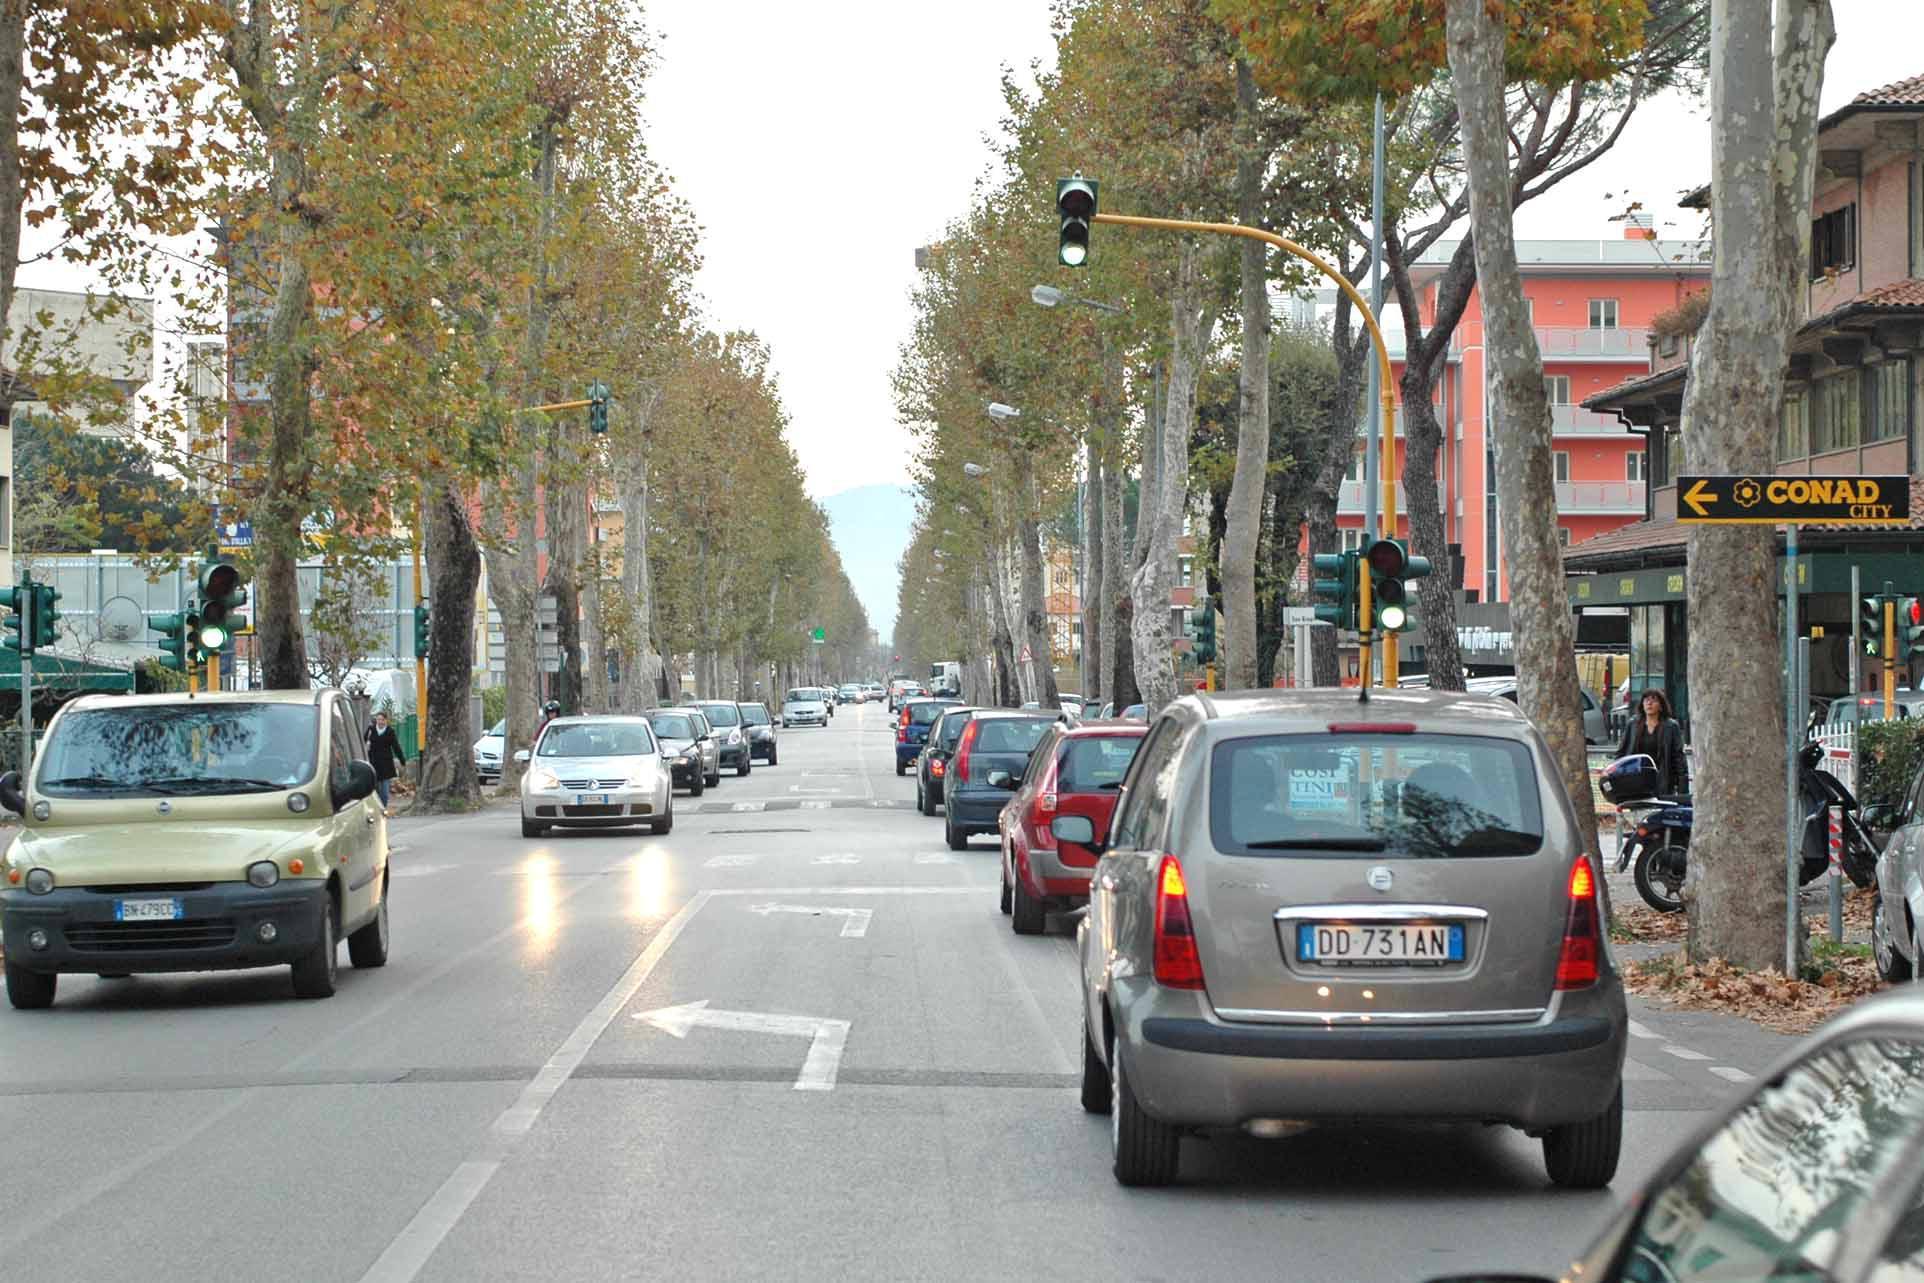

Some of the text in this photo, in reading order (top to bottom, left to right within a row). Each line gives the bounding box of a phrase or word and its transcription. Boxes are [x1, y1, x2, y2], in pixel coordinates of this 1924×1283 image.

[1766, 480, 1880, 504] CONAD
[1849, 504, 1893, 518] CITY
[1318, 929, 1351, 956] DD
[1361, 928, 1446, 956] 731AN
